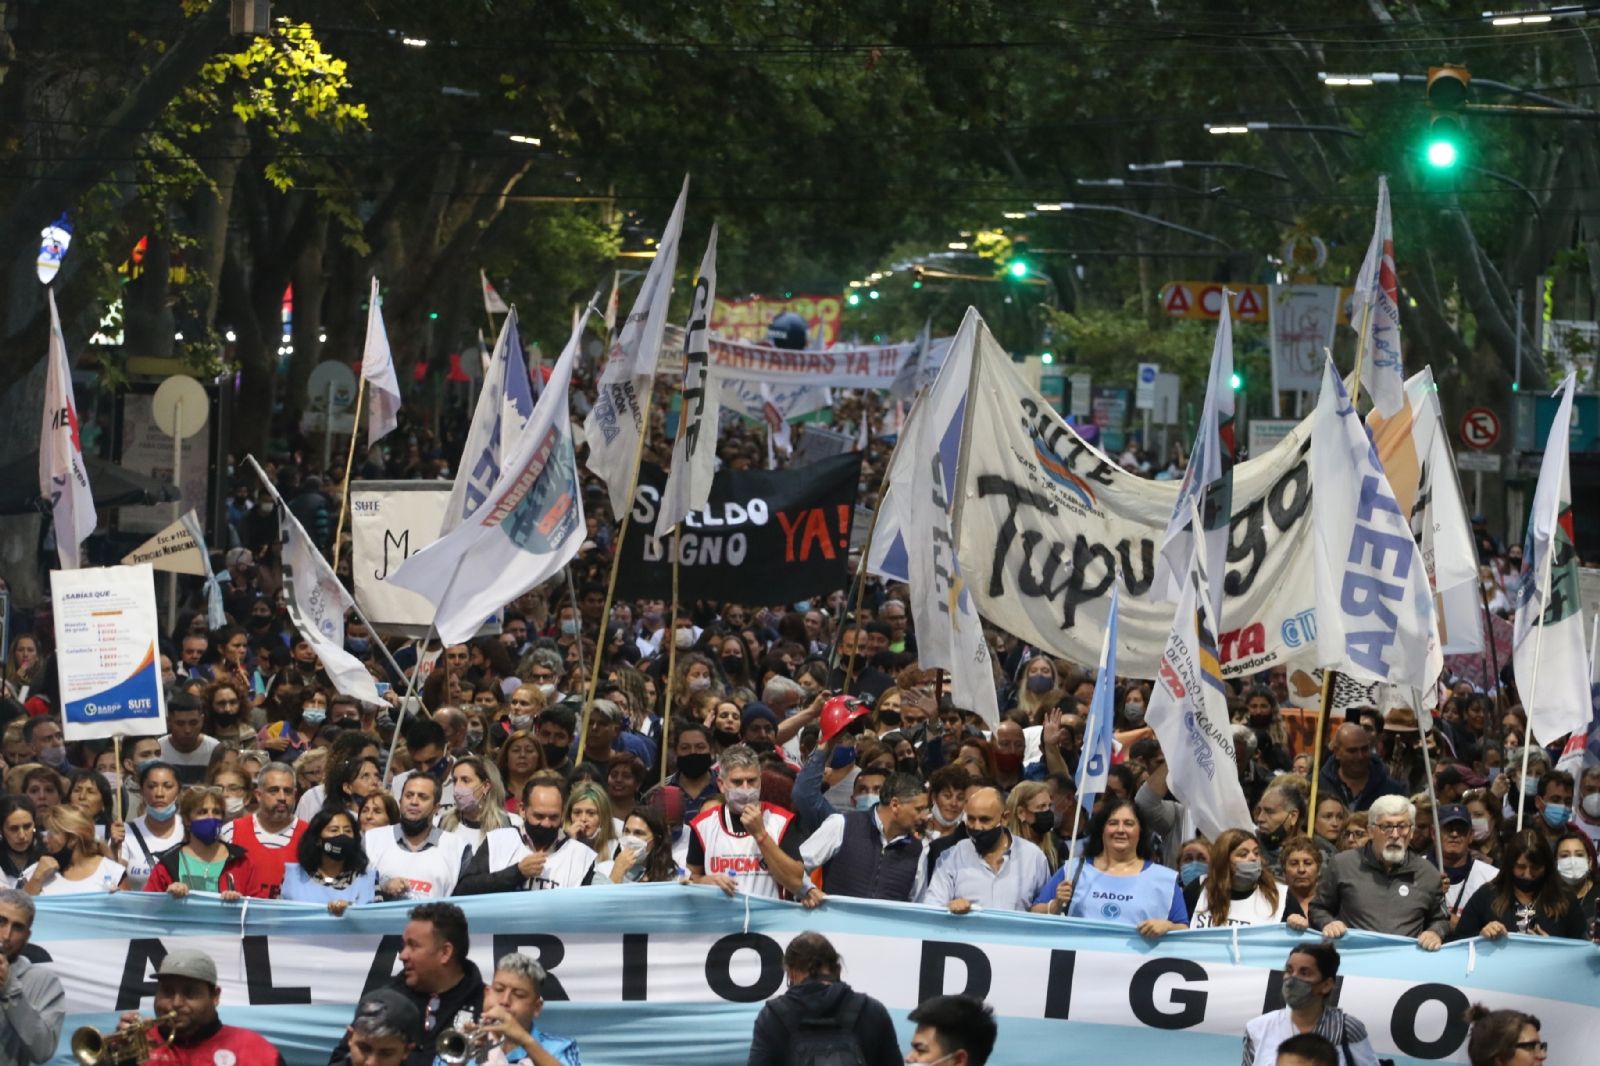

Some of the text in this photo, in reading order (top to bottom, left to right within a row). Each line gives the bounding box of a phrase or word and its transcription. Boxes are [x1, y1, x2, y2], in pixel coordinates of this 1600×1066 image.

[1166, 285, 1261, 316] ACA
[845, 351, 869, 376] YA
[355, 501, 380, 511] SUTE
[776, 504, 850, 562] YA!
[94, 589, 110, 598] QUE
[1165, 649, 1178, 664] DE
[128, 698, 151, 710] SUTE
[1092, 892, 1134, 902] SADOP
[917, 940, 1470, 1060] DIGO
